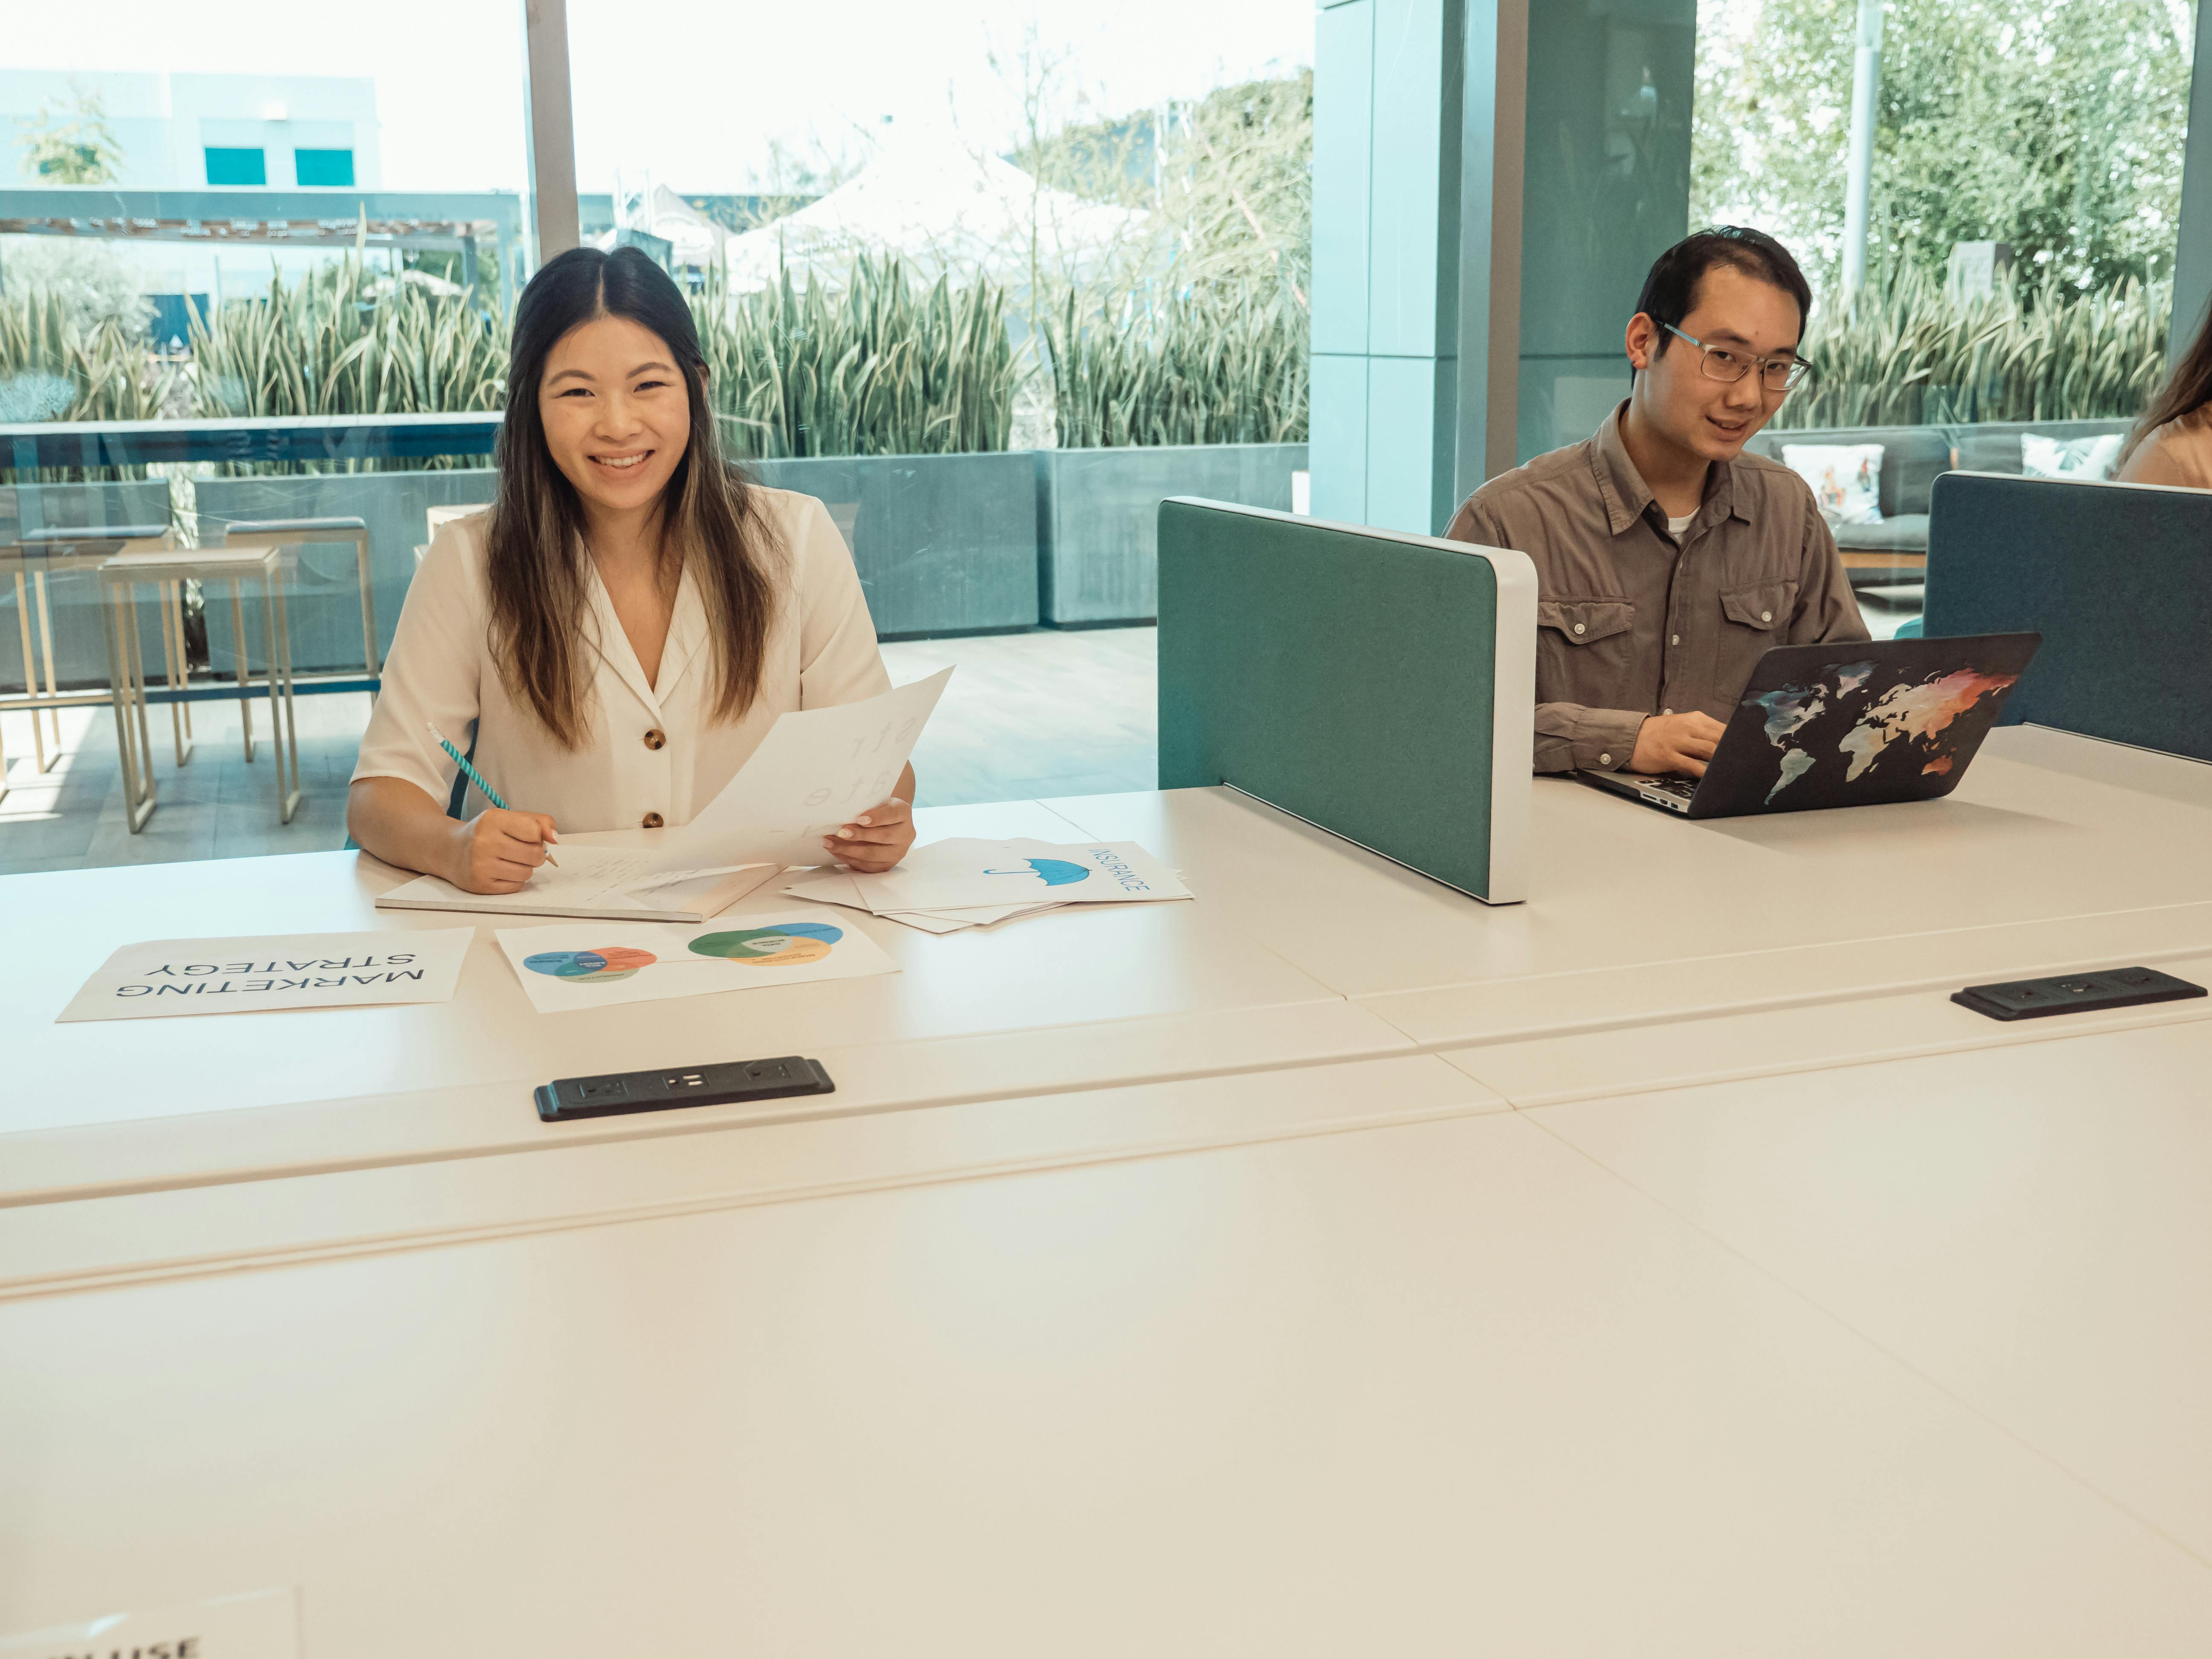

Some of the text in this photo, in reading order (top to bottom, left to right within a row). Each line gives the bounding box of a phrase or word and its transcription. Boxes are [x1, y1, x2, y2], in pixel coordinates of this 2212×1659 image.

[1088, 849, 1150, 891] INSURANCE
[144, 953, 417, 975] STRATEGY
[116, 969, 424, 996] MARKETING
